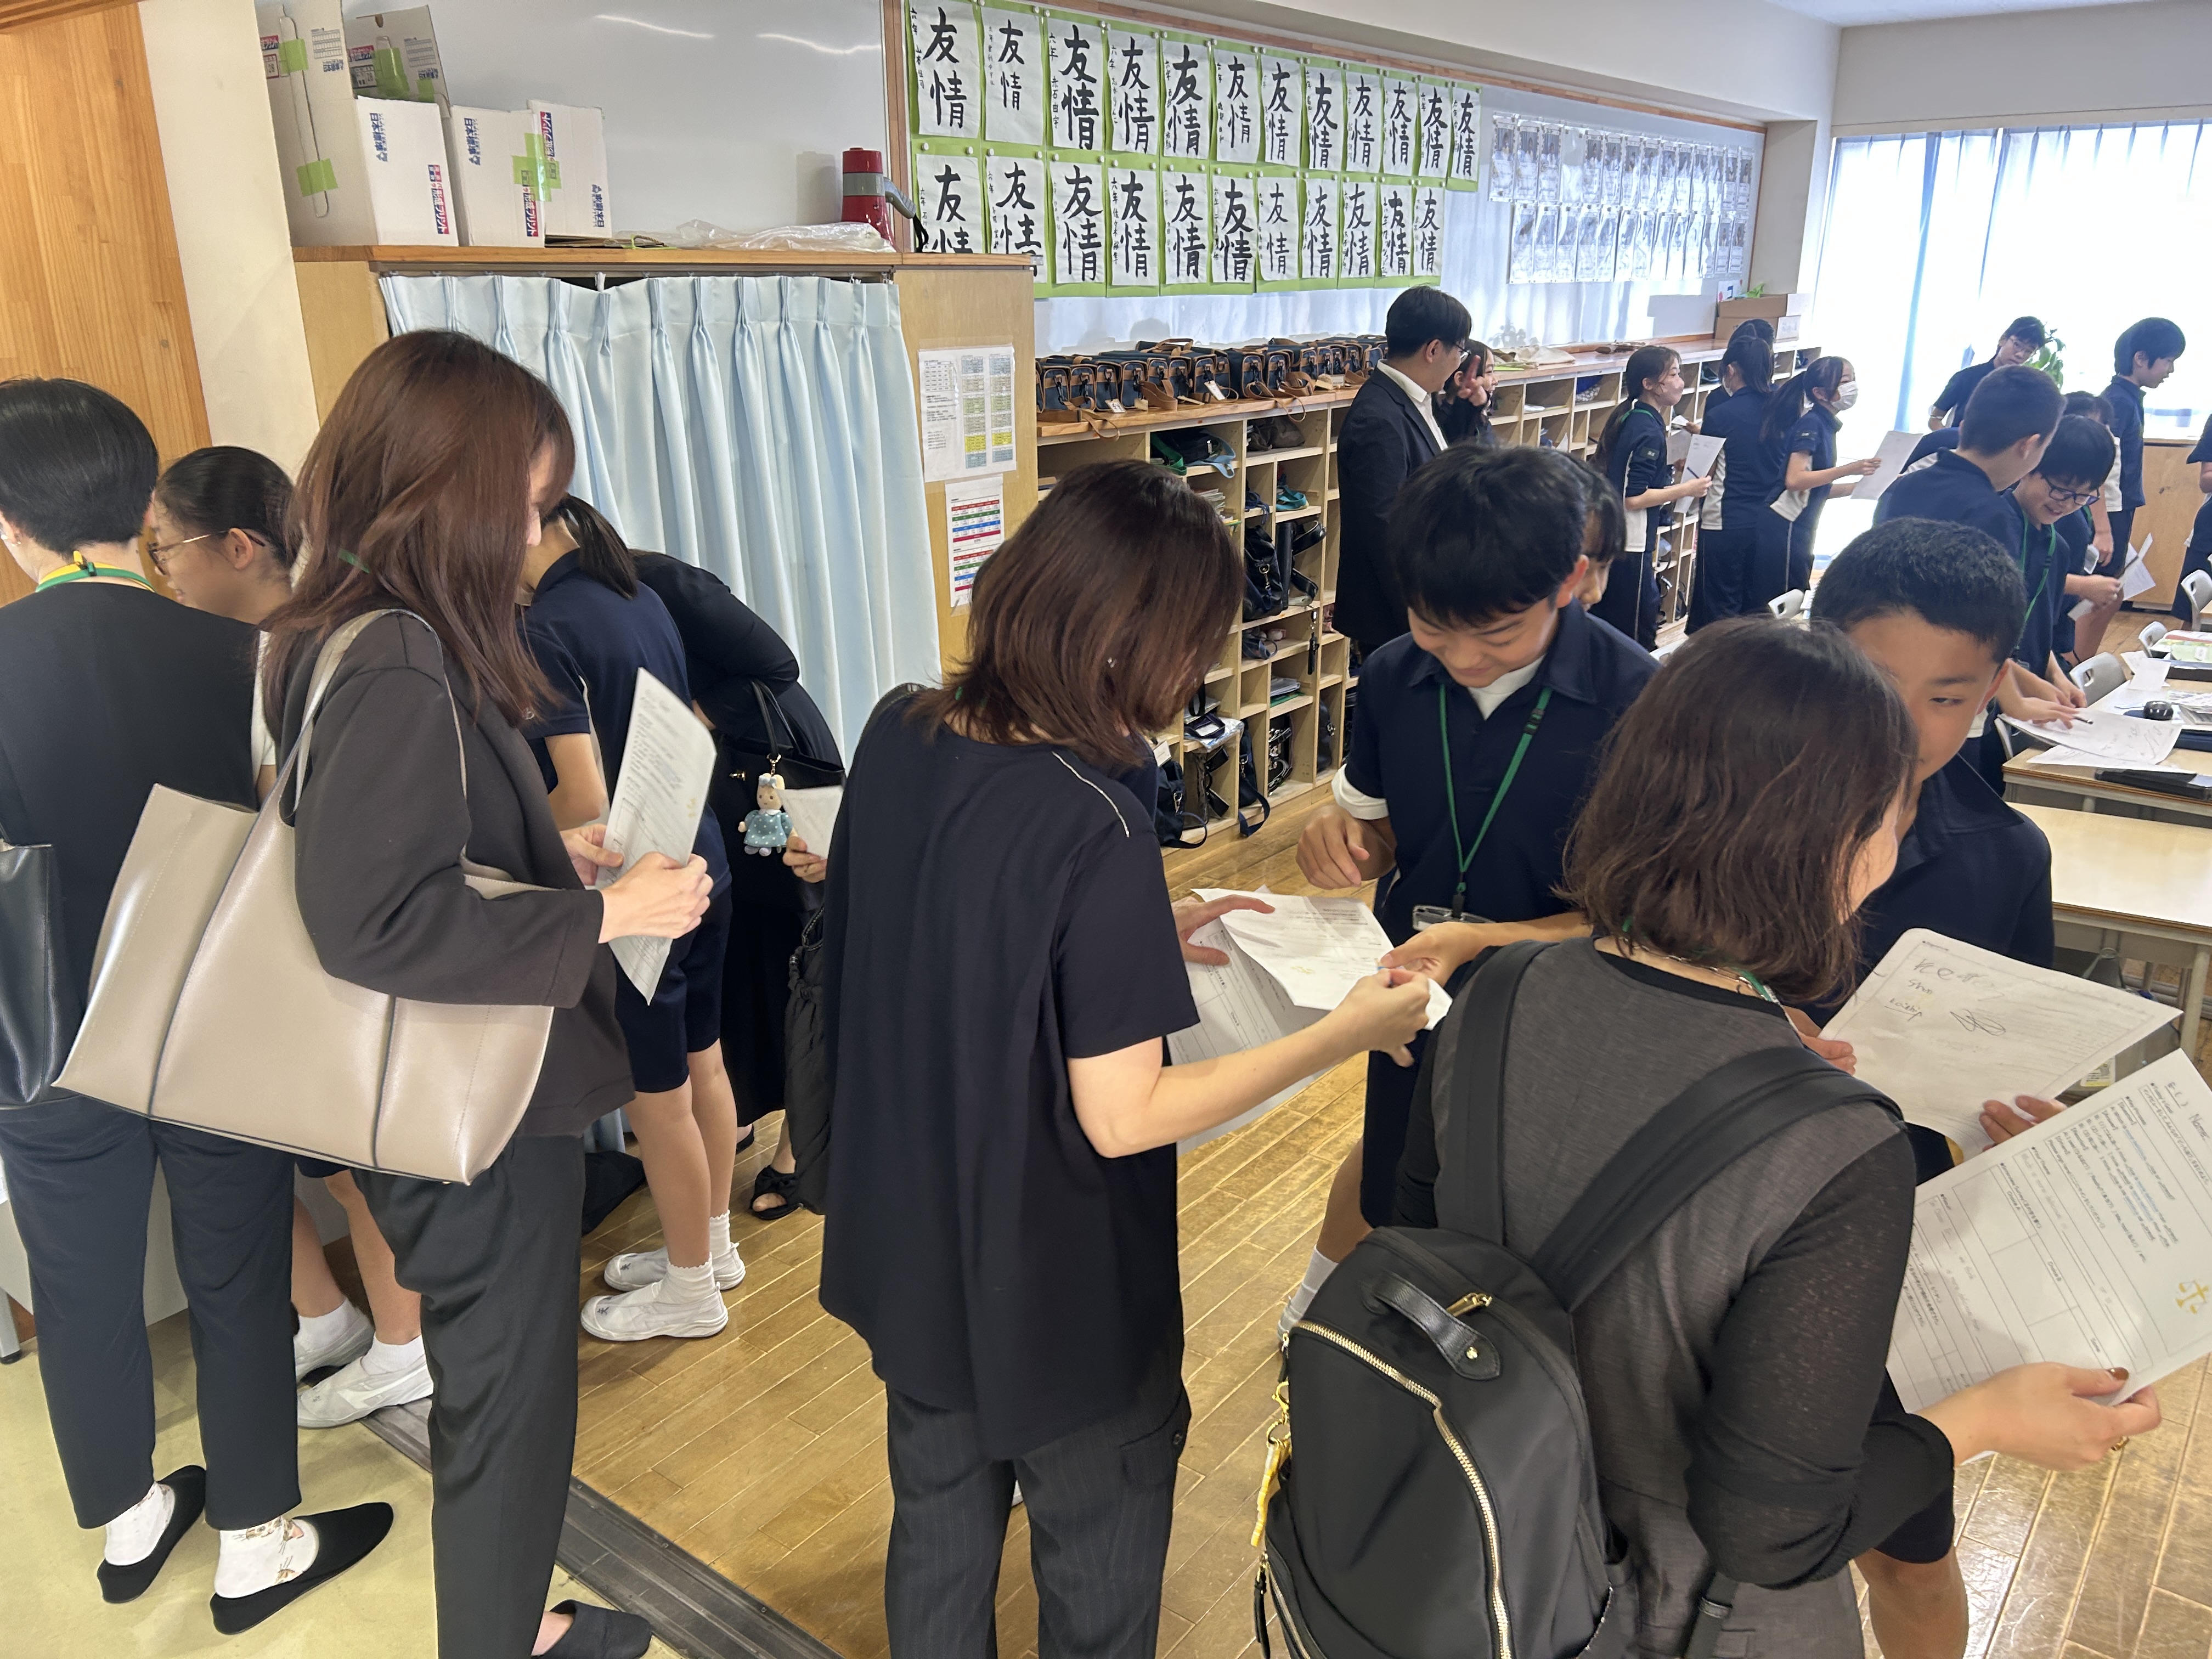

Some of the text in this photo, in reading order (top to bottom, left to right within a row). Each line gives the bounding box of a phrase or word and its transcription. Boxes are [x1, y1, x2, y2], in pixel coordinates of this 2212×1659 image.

[923, 7, 967, 128] 友情
[998, 19, 1024, 110] 友情
[1049, 32, 1058, 61] 六年
[1059, 25, 1099, 150] 友情
[1109, 45, 1117, 71] 六年
[1119, 36, 1154, 154] 友情
[1168, 45, 1203, 155] 友情
[1227, 56, 1250, 148] 友情
[1268, 62, 1293, 160] 友情
[1311, 73, 1338, 168] 友情
[1351, 76, 1374, 167] 友情
[1391, 82, 1411, 165] 友情
[1424, 87, 1447, 168] 友情
[1457, 93, 1475, 176] 友情
[996, 162, 1042, 276] 友情
[1063, 165, 1102, 281] 友情
[1111, 177, 1118, 204] 六年
[1121, 171, 1150, 277] 友情
[1172, 174, 1205, 278] 友情
[1220, 179, 1253, 281] 友情
[1267, 183, 1289, 274] 友情
[1309, 187, 1332, 278] 友情
[1348, 184, 1370, 275] 友情
[1389, 191, 1409, 274] 友情
[1419, 189, 1440, 271] 友情
